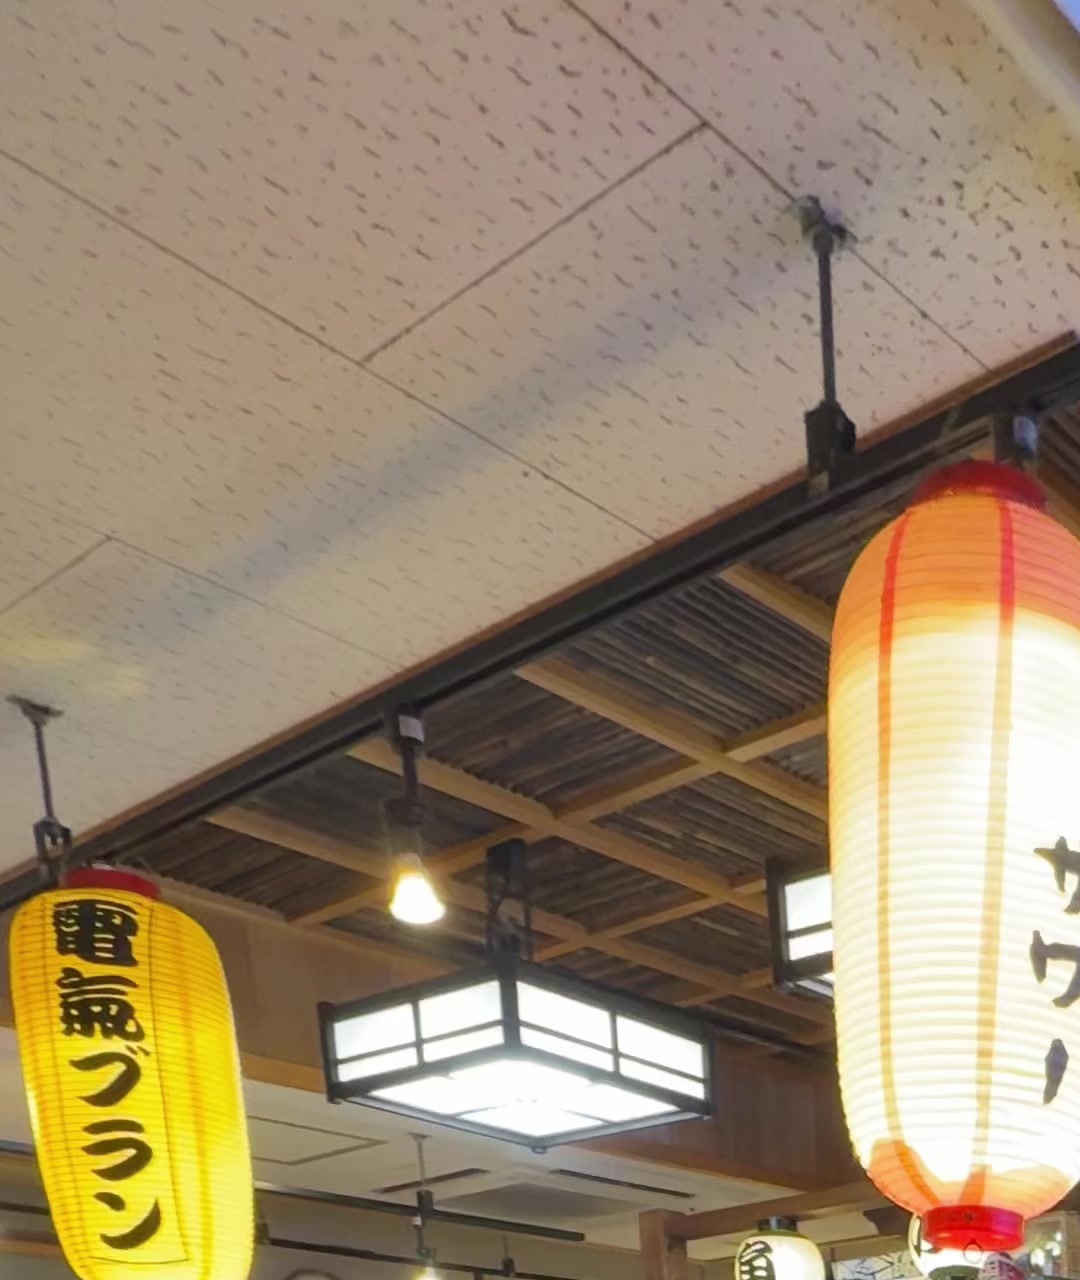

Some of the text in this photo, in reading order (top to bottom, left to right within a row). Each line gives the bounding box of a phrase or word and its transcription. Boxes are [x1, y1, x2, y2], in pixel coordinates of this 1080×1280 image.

[52, 898, 162, 1252] 電氣ブラン
